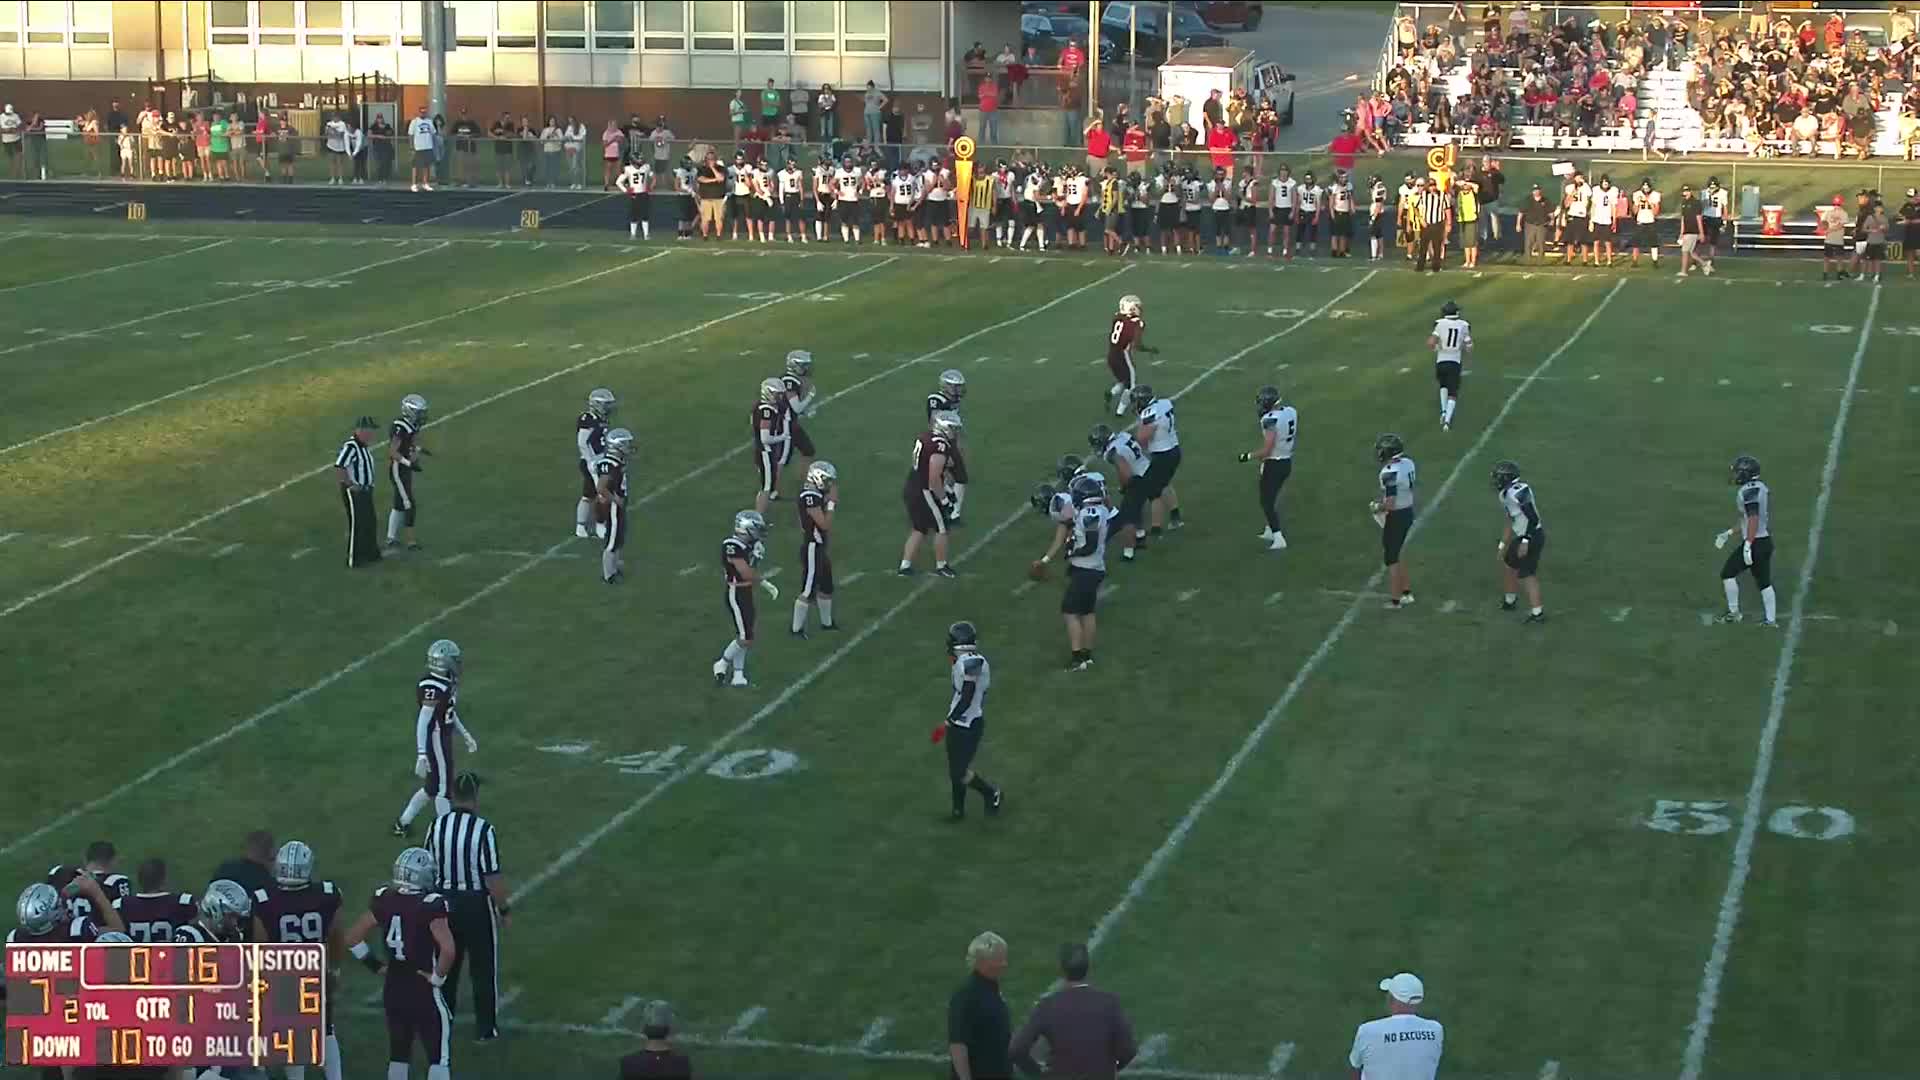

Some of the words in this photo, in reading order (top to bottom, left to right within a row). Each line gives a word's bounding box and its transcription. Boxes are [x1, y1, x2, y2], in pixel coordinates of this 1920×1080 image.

[633, 173, 646, 184] 27
[521, 210, 538, 226] 20
[1110, 320, 1124, 345] 8
[1446, 327, 1459, 348] 11
[424, 688, 436, 700] 27
[279, 911, 323, 942] 69
[384, 914, 407, 961] 4
[1383, 1032, 1397, 1044] NO
[1399, 1030, 1436, 1042] EXCUSES
